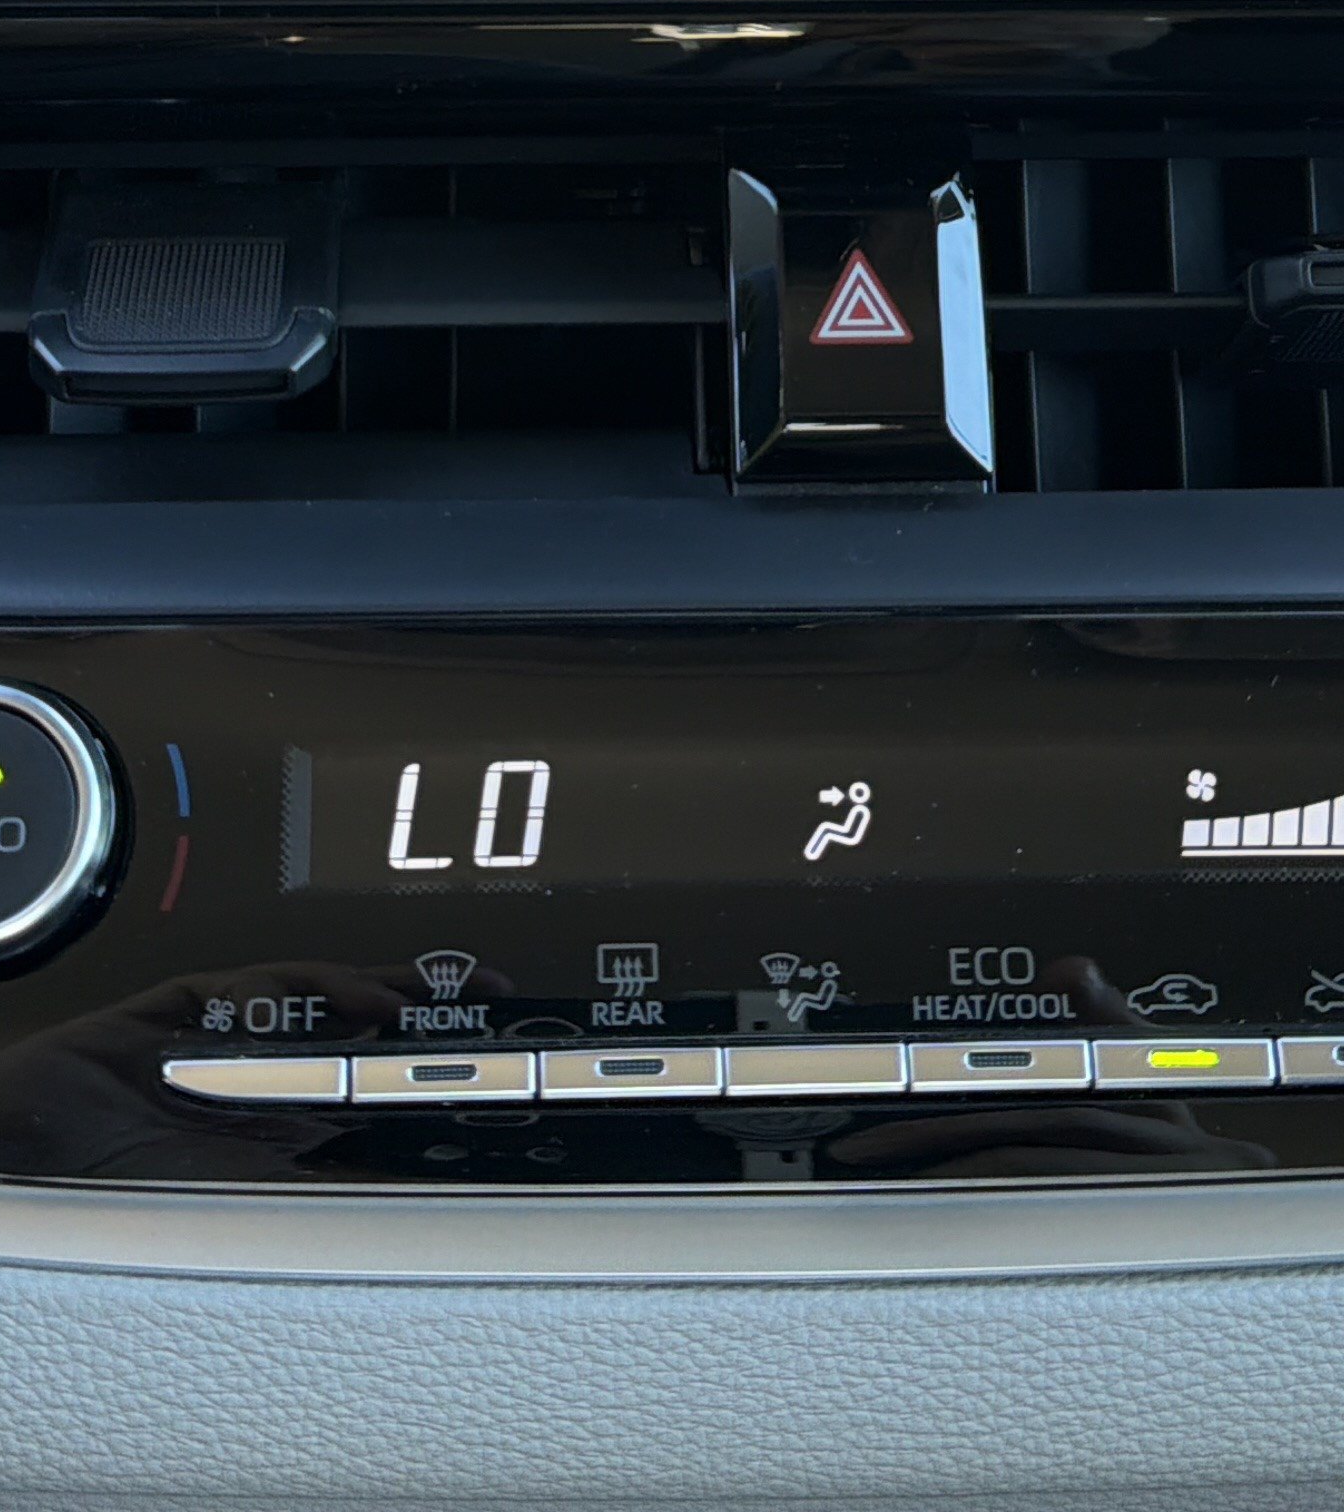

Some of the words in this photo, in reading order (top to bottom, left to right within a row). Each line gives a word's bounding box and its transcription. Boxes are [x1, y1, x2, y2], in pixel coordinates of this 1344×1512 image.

[948, 946, 1035, 986] ECO
[245, 996, 326, 1033] OFF
[400, 1004, 490, 1031] FRONT
[591, 1000, 665, 1026] REAR
[912, 993, 1077, 1023] HEAT/COOL
